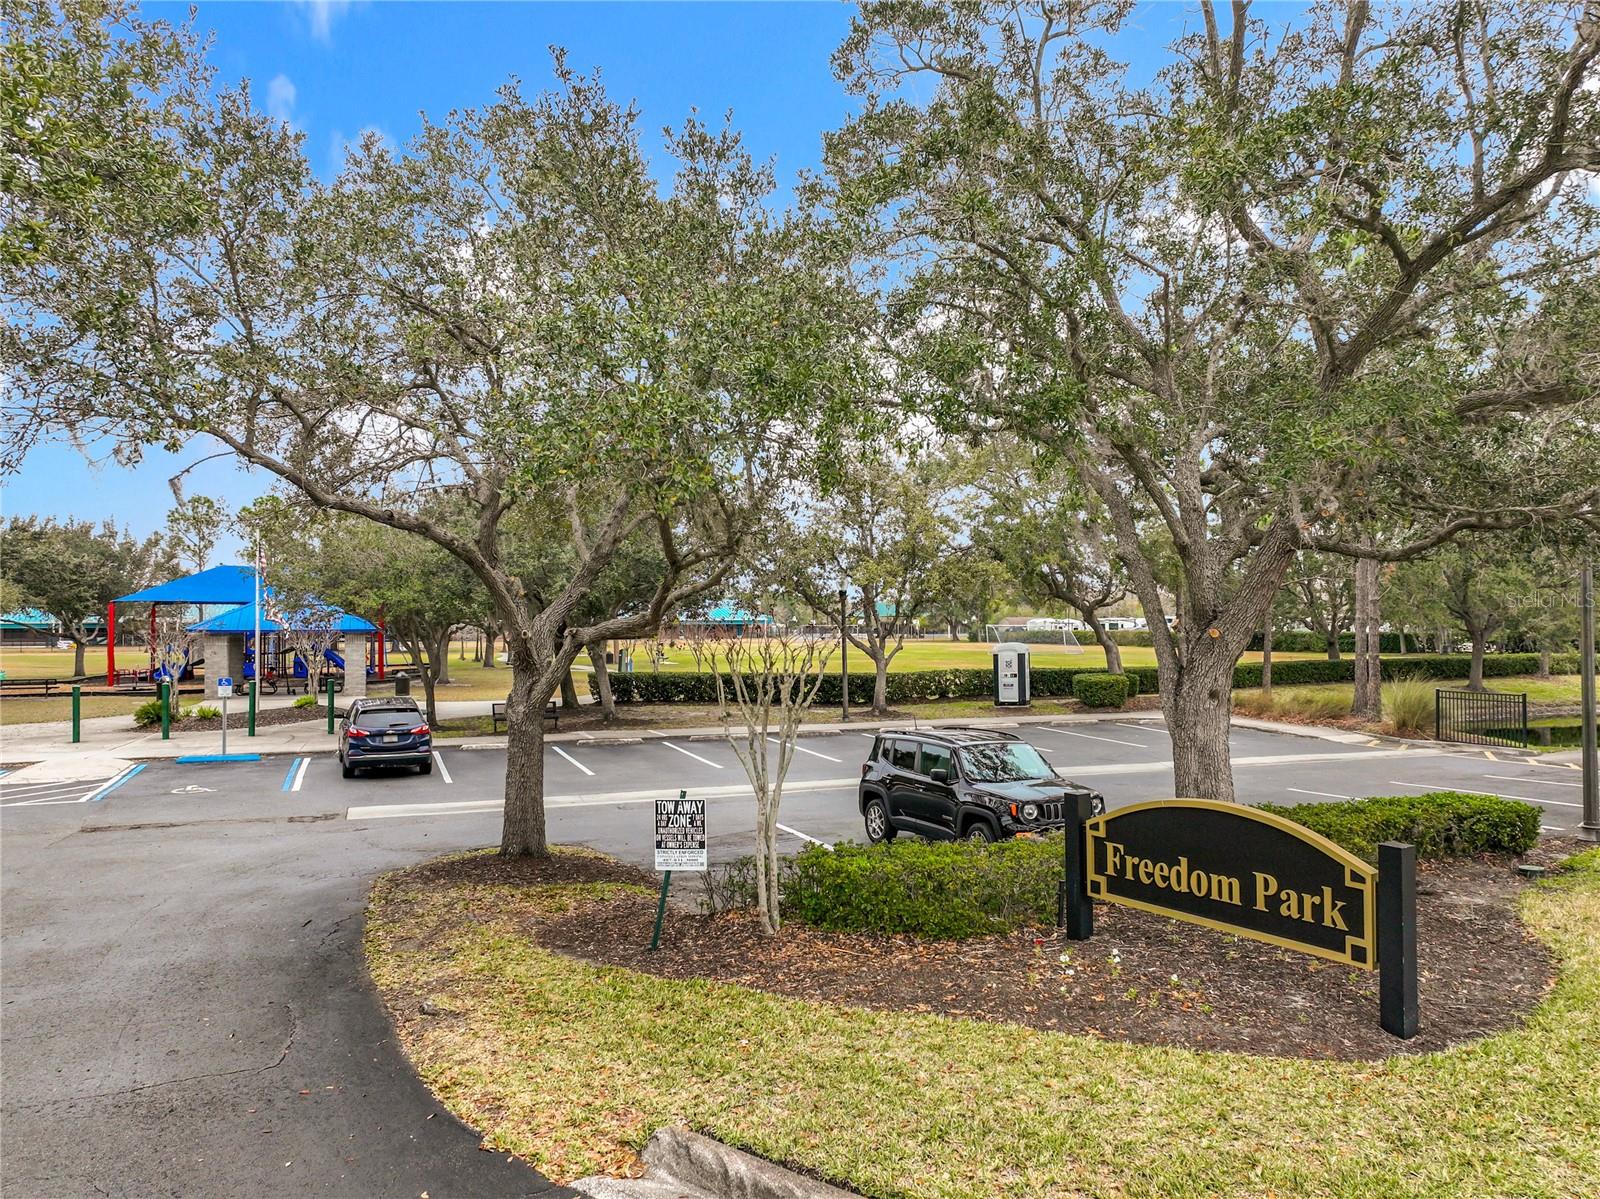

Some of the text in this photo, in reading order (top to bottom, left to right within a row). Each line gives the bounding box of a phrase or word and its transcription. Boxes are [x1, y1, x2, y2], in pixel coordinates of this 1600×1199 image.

[657, 801, 703, 814] TOW AWAY
[669, 814, 692, 827] ZONE
[1103, 841, 1349, 931] Freedom Park
